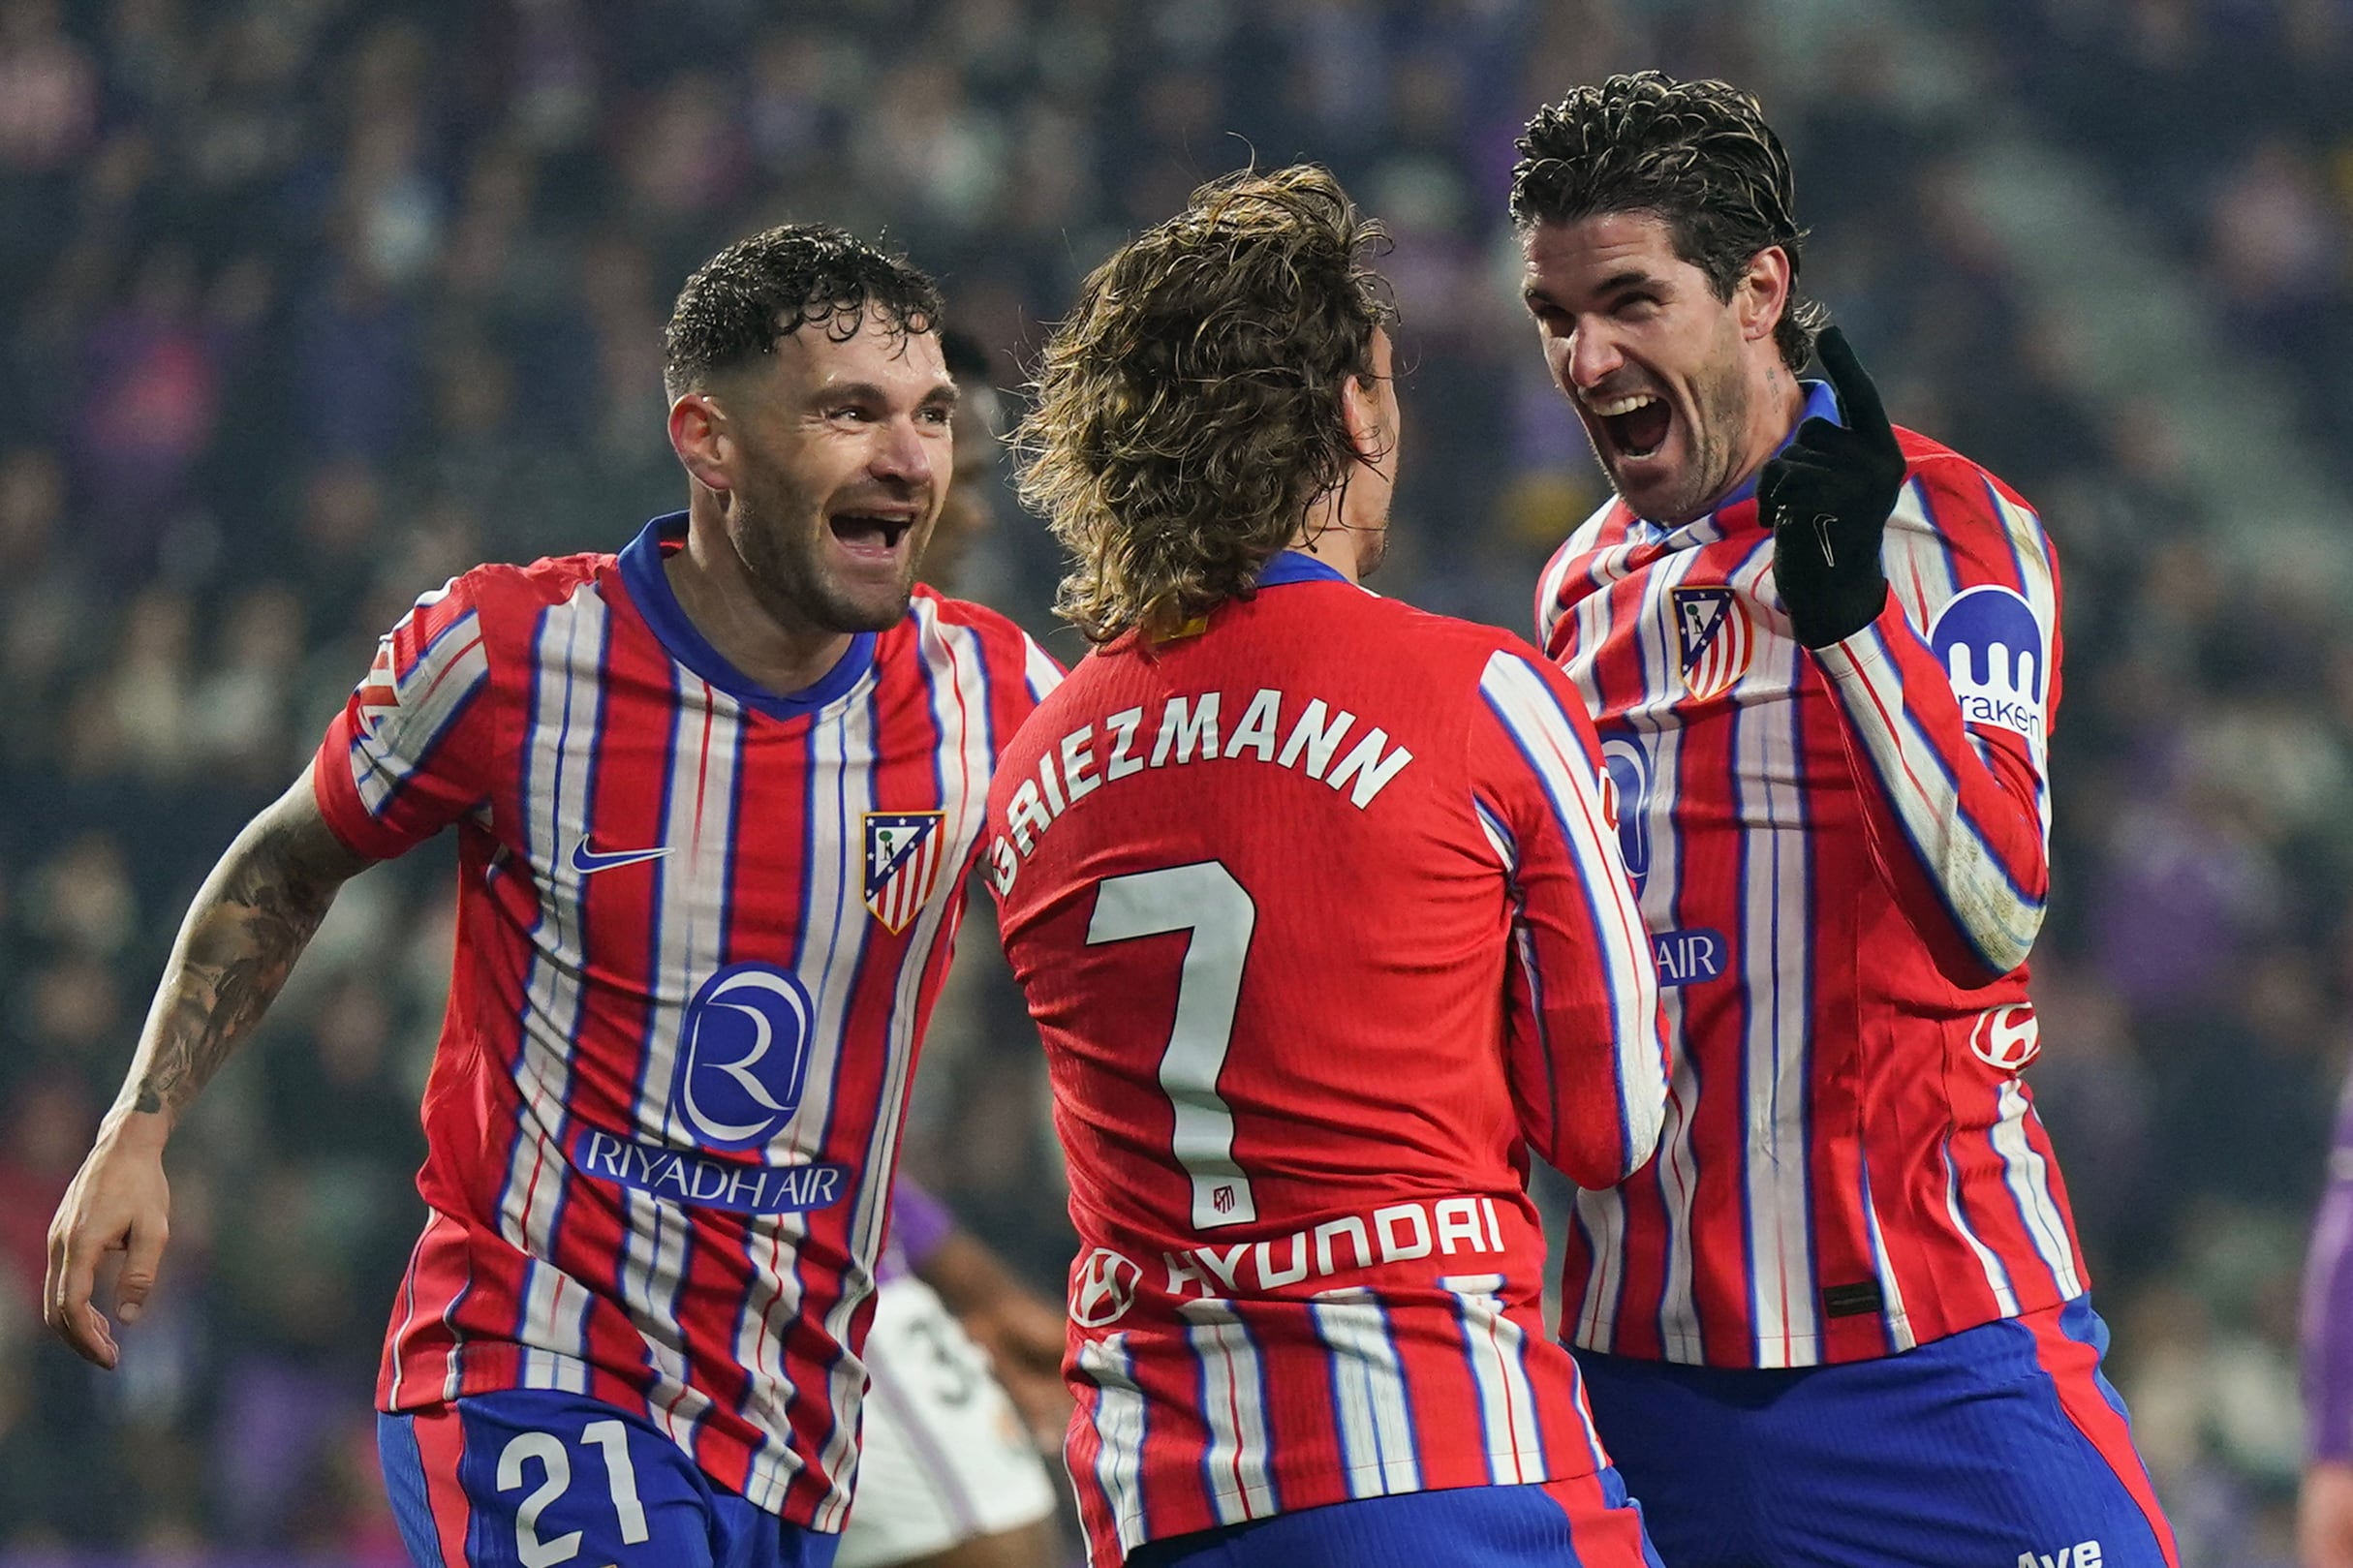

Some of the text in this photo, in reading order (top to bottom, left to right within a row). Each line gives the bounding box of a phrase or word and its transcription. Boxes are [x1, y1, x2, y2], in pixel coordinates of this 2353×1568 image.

[1958, 694, 2041, 742] raken
[1657, 936, 1717, 979] AIR
[1086, 860, 1255, 1230] 7
[587, 1131, 839, 1208] RIYADH AIR
[1164, 1198, 1505, 1299] HYUNDAI
[496, 1420, 649, 1568] 21
